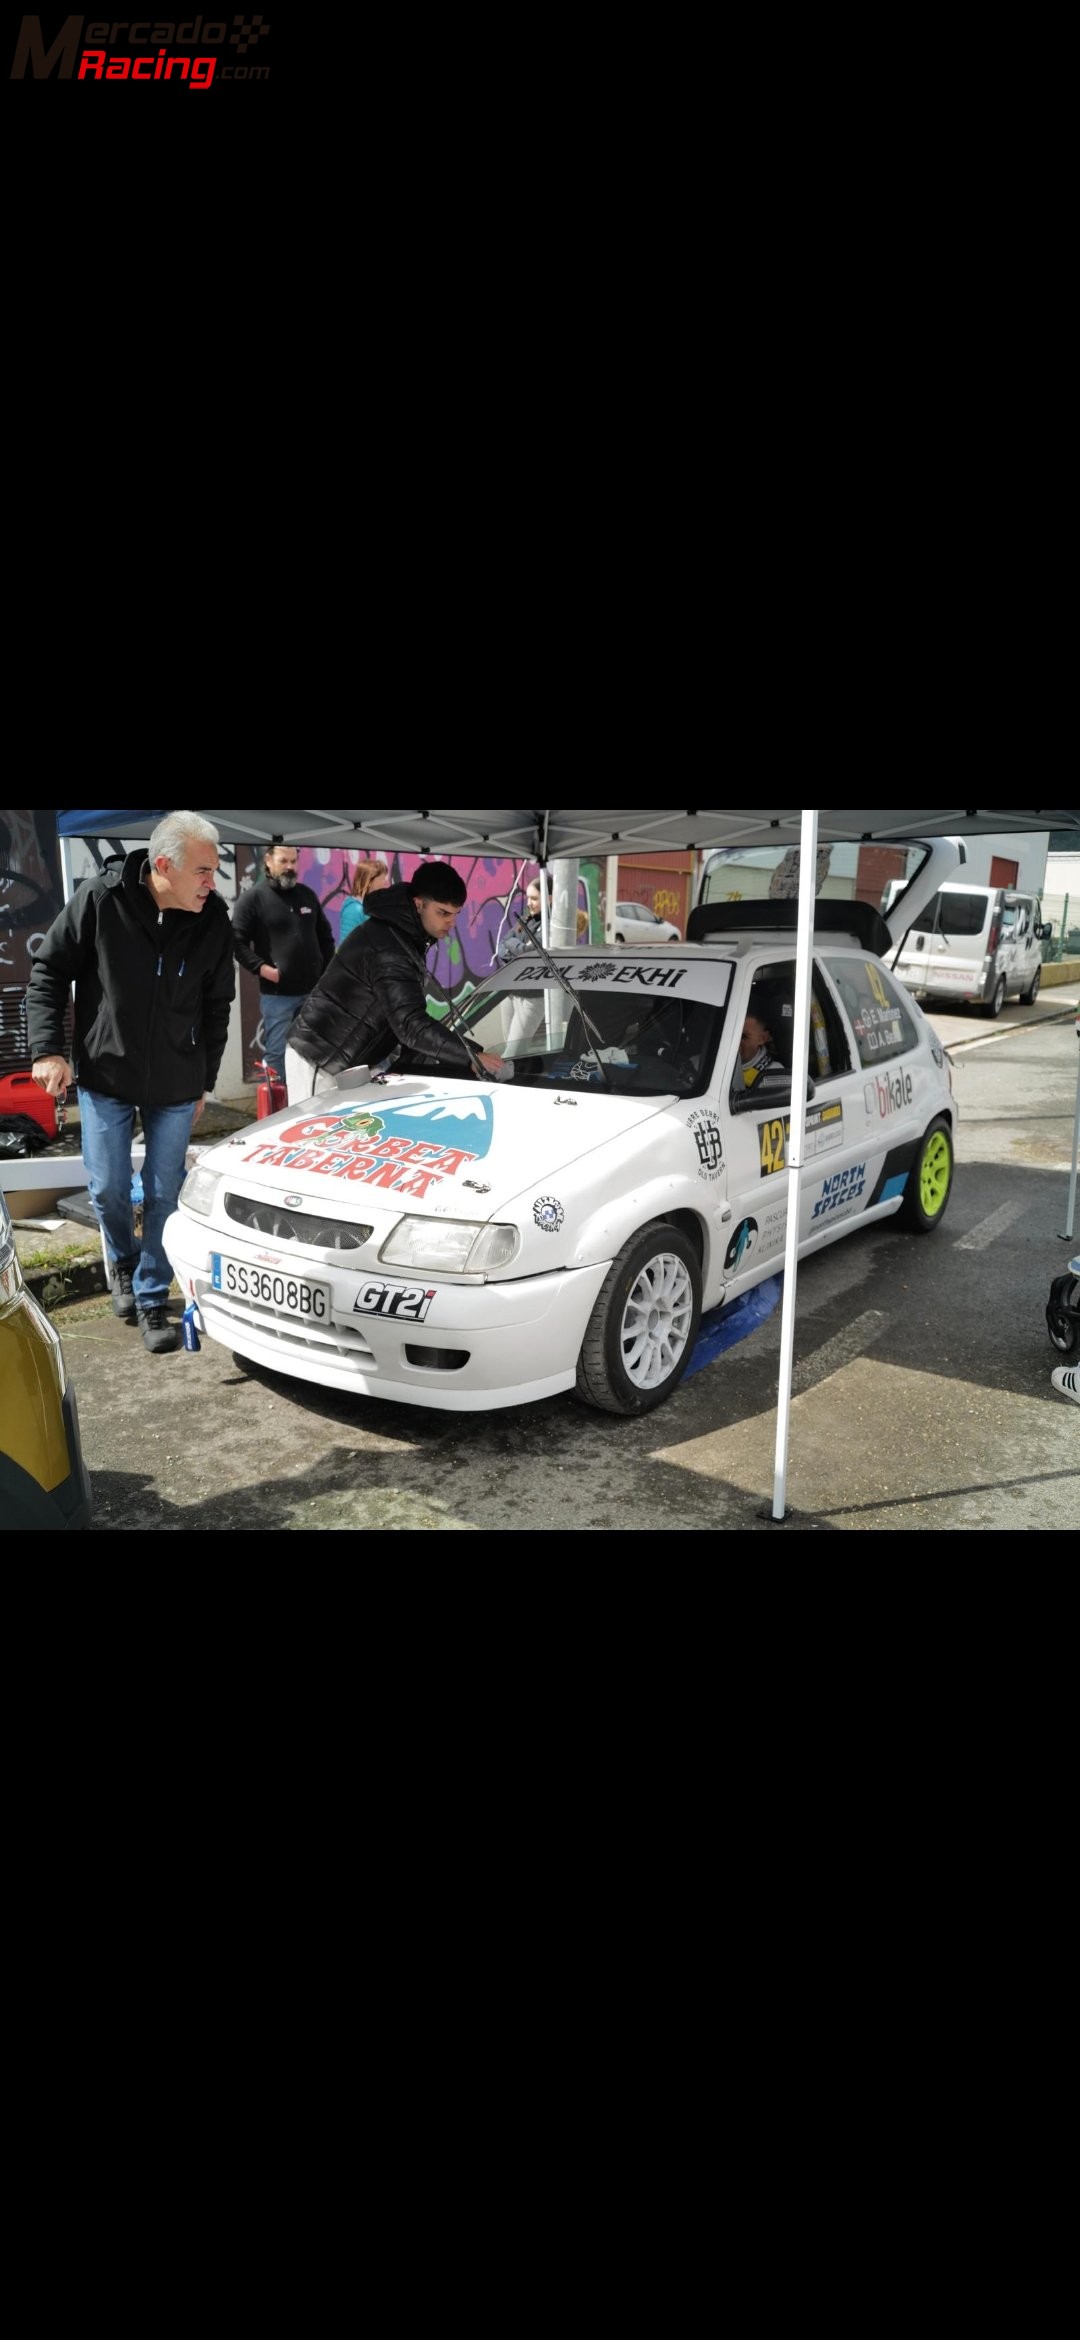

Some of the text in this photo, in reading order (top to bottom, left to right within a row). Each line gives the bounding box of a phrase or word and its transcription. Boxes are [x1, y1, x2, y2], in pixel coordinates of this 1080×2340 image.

[934, 972, 974, 982] NISSAN
[875, 1066, 912, 1118] bikale
[761, 1119, 785, 1174] 42
[242, 1143, 445, 1199] TABERNA
[821, 1162, 866, 1199] NORTH
[811, 1180, 866, 1220] SPICES
[226, 1263, 326, 1318] SS3608BG
[355, 1281, 437, 1320] GT2i
